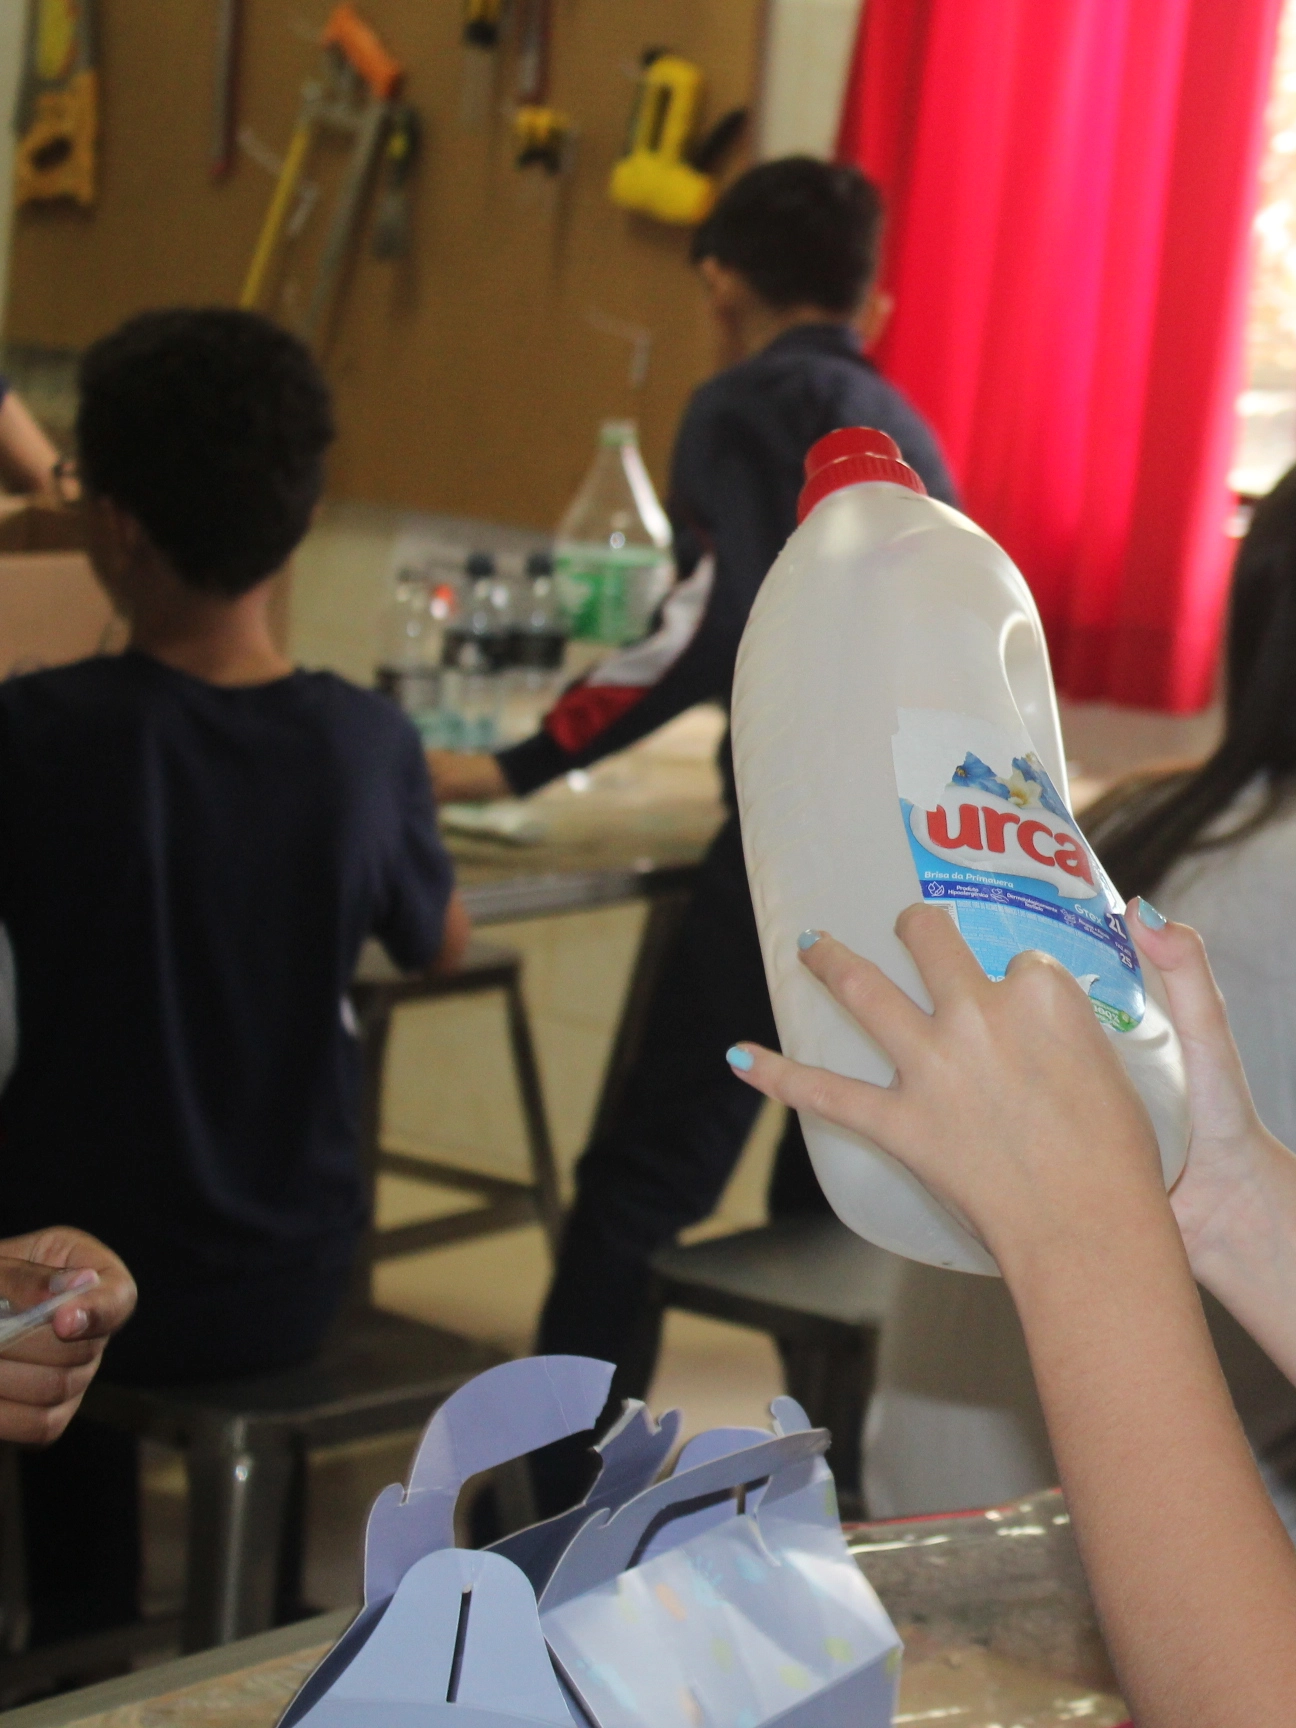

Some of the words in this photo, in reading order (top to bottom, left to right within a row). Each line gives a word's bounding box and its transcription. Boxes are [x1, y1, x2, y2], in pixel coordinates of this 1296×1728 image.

[926, 804, 1095, 886] urca
[924, 871, 949, 879] Brisa
[951, 872, 964, 880] da
[965, 873, 1014, 889] Primavera
[1105, 912, 1127, 940] 2L
[1119, 952, 1133, 969] 25
